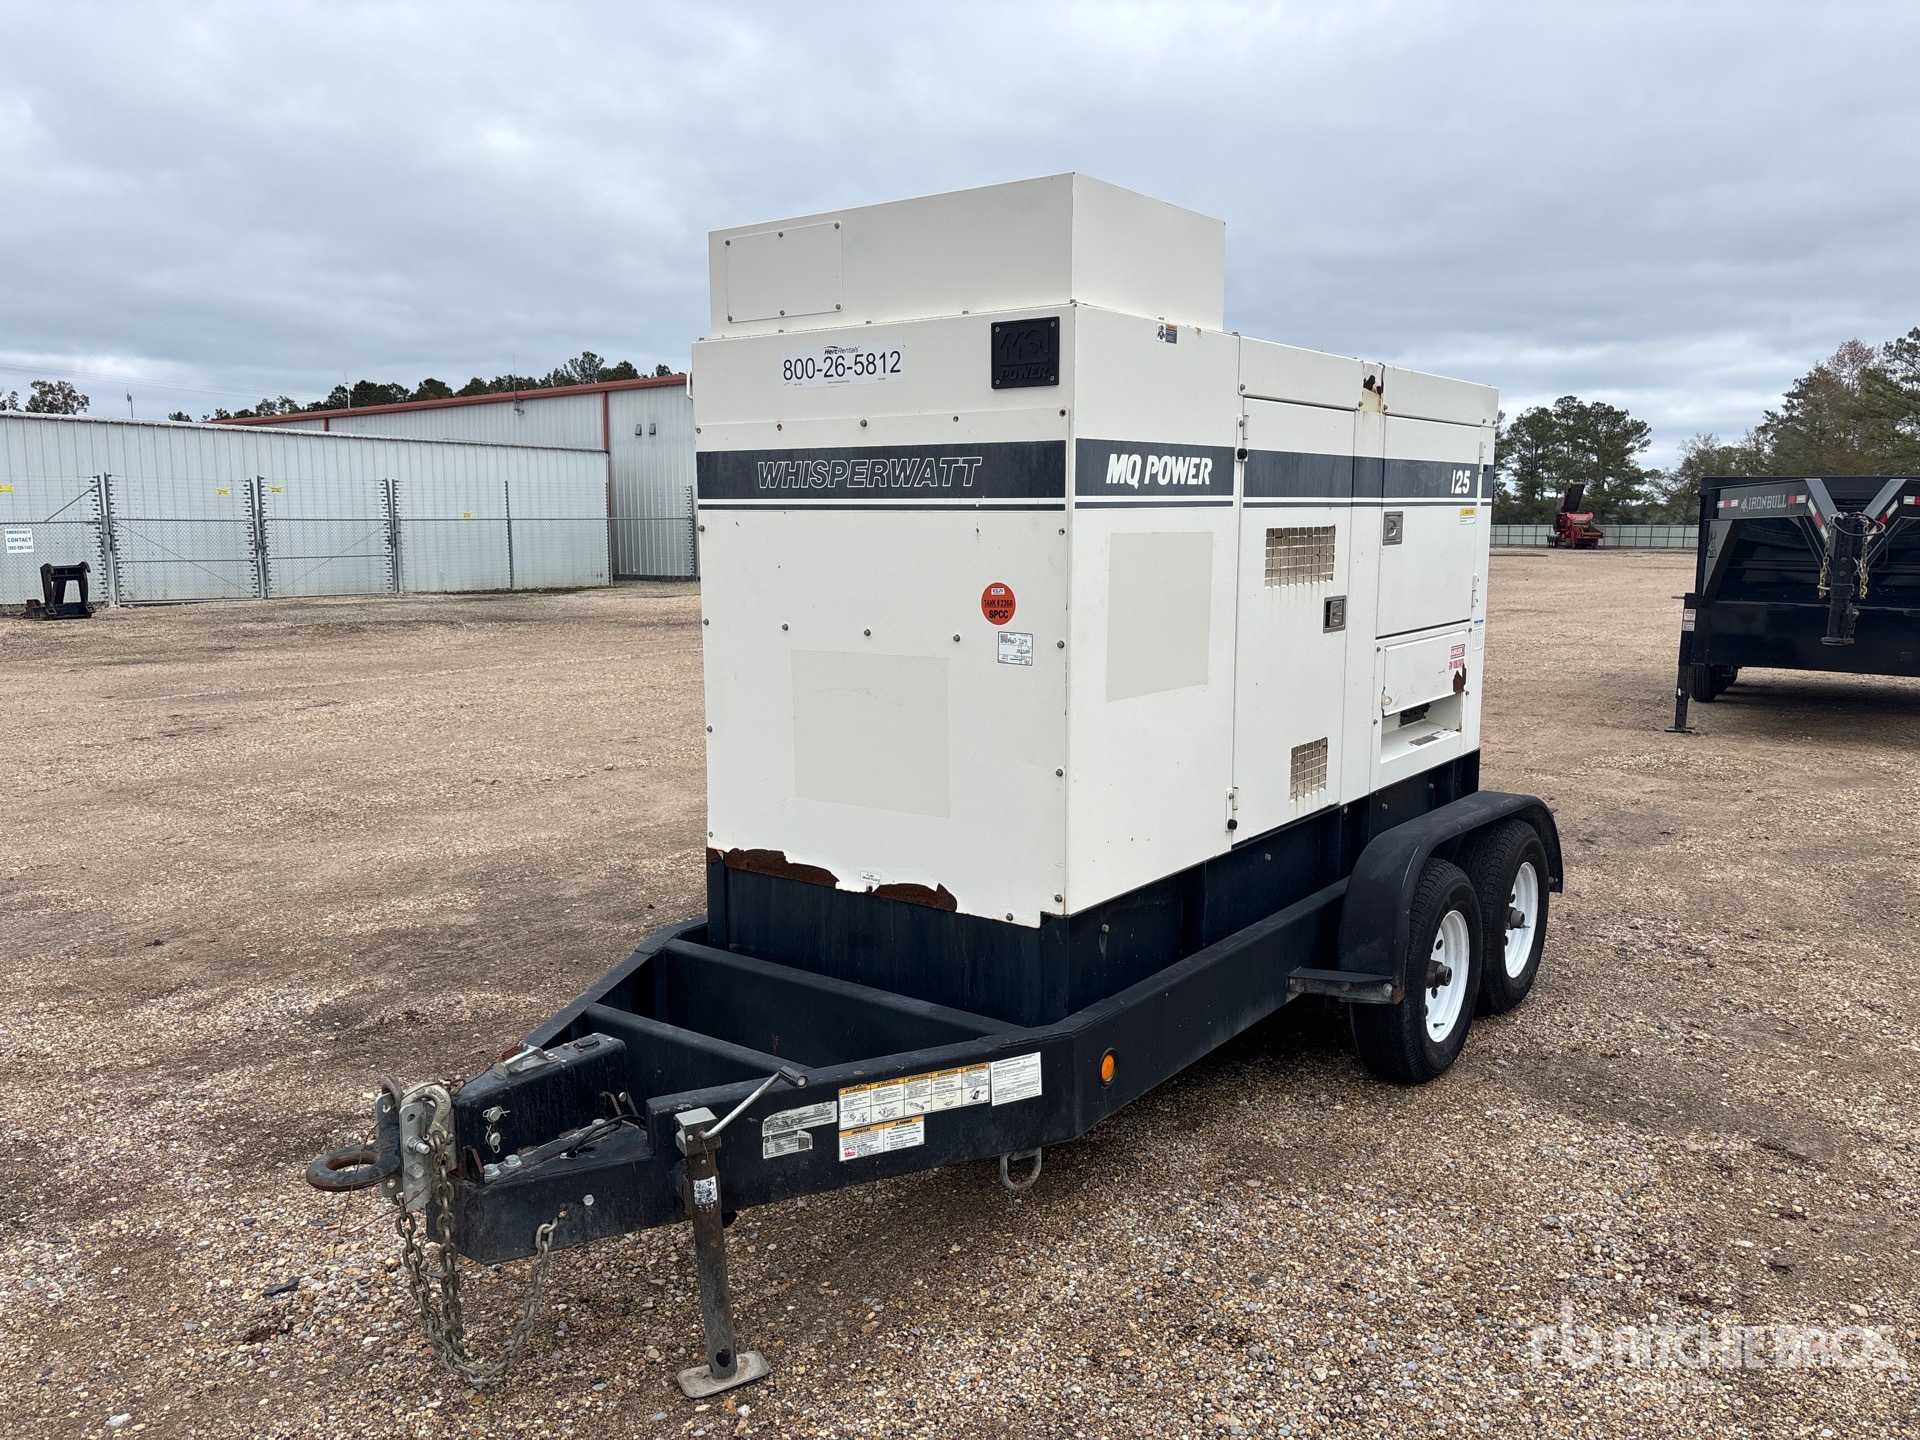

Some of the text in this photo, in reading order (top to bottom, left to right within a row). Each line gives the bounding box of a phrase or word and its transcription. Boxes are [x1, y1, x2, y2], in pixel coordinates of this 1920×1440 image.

[783, 351, 901, 381] 800-26-5812
[1000, 366, 1050, 380] POWER
[758, 457, 982, 489] WHISPERWATT
[1105, 454, 1213, 490] MQ POWER
[1450, 469, 1471, 494] 125
[1748, 495, 1787, 510] IRONBULL
[984, 599, 997, 607] TANK
[989, 610, 1008, 618] SPCC
